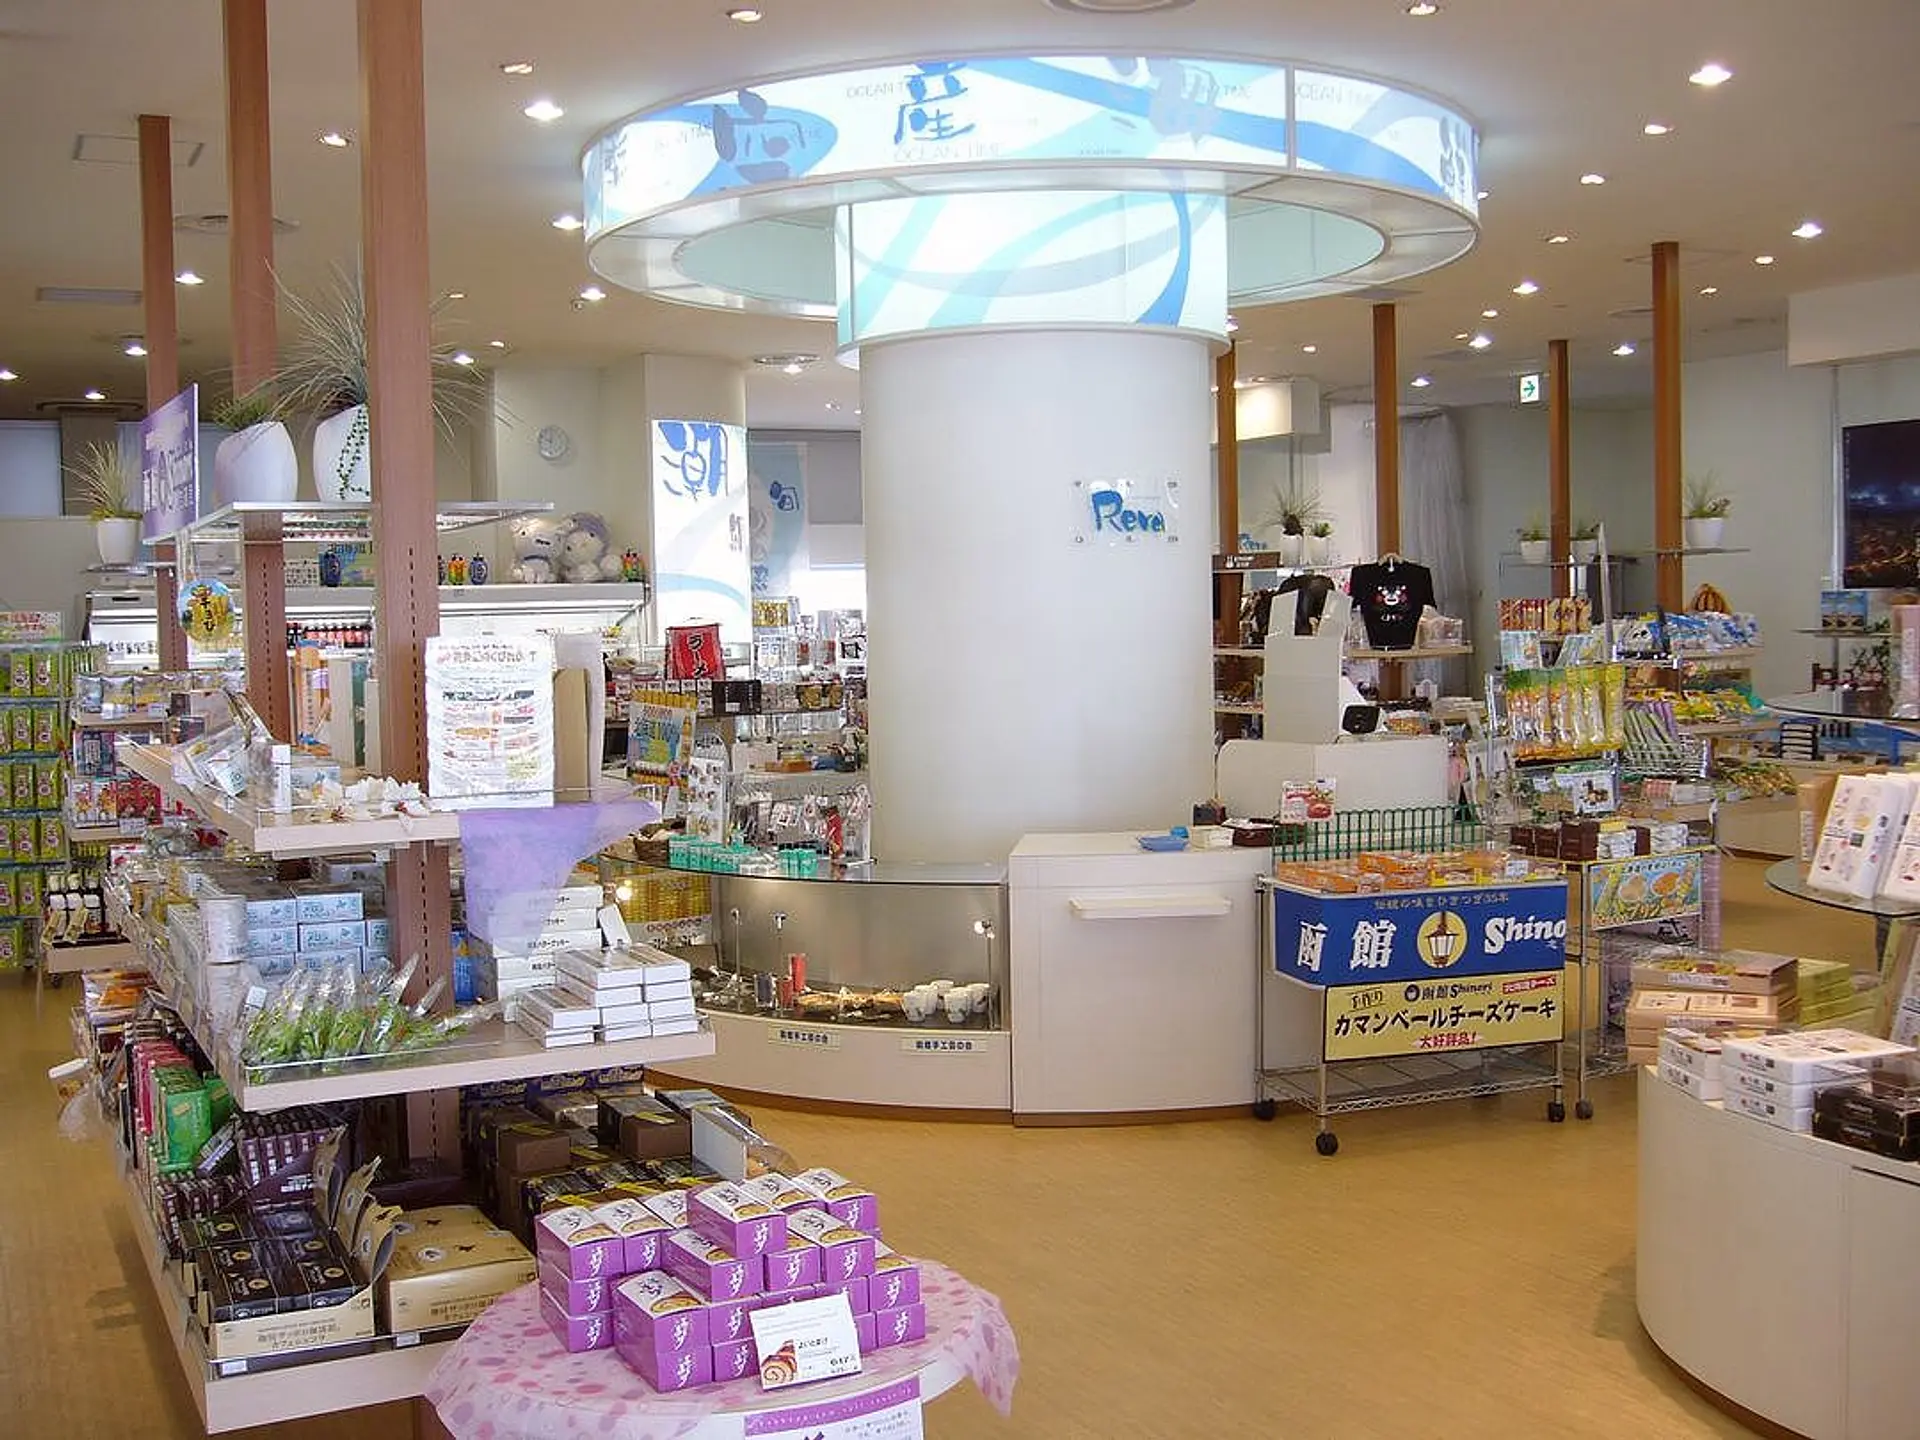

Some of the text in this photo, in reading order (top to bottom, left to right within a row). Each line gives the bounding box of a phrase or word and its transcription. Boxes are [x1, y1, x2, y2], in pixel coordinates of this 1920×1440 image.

[1297, 919, 1397, 972] 函館
[1334, 998, 1556, 1037] カマンベールチーズケーキ
